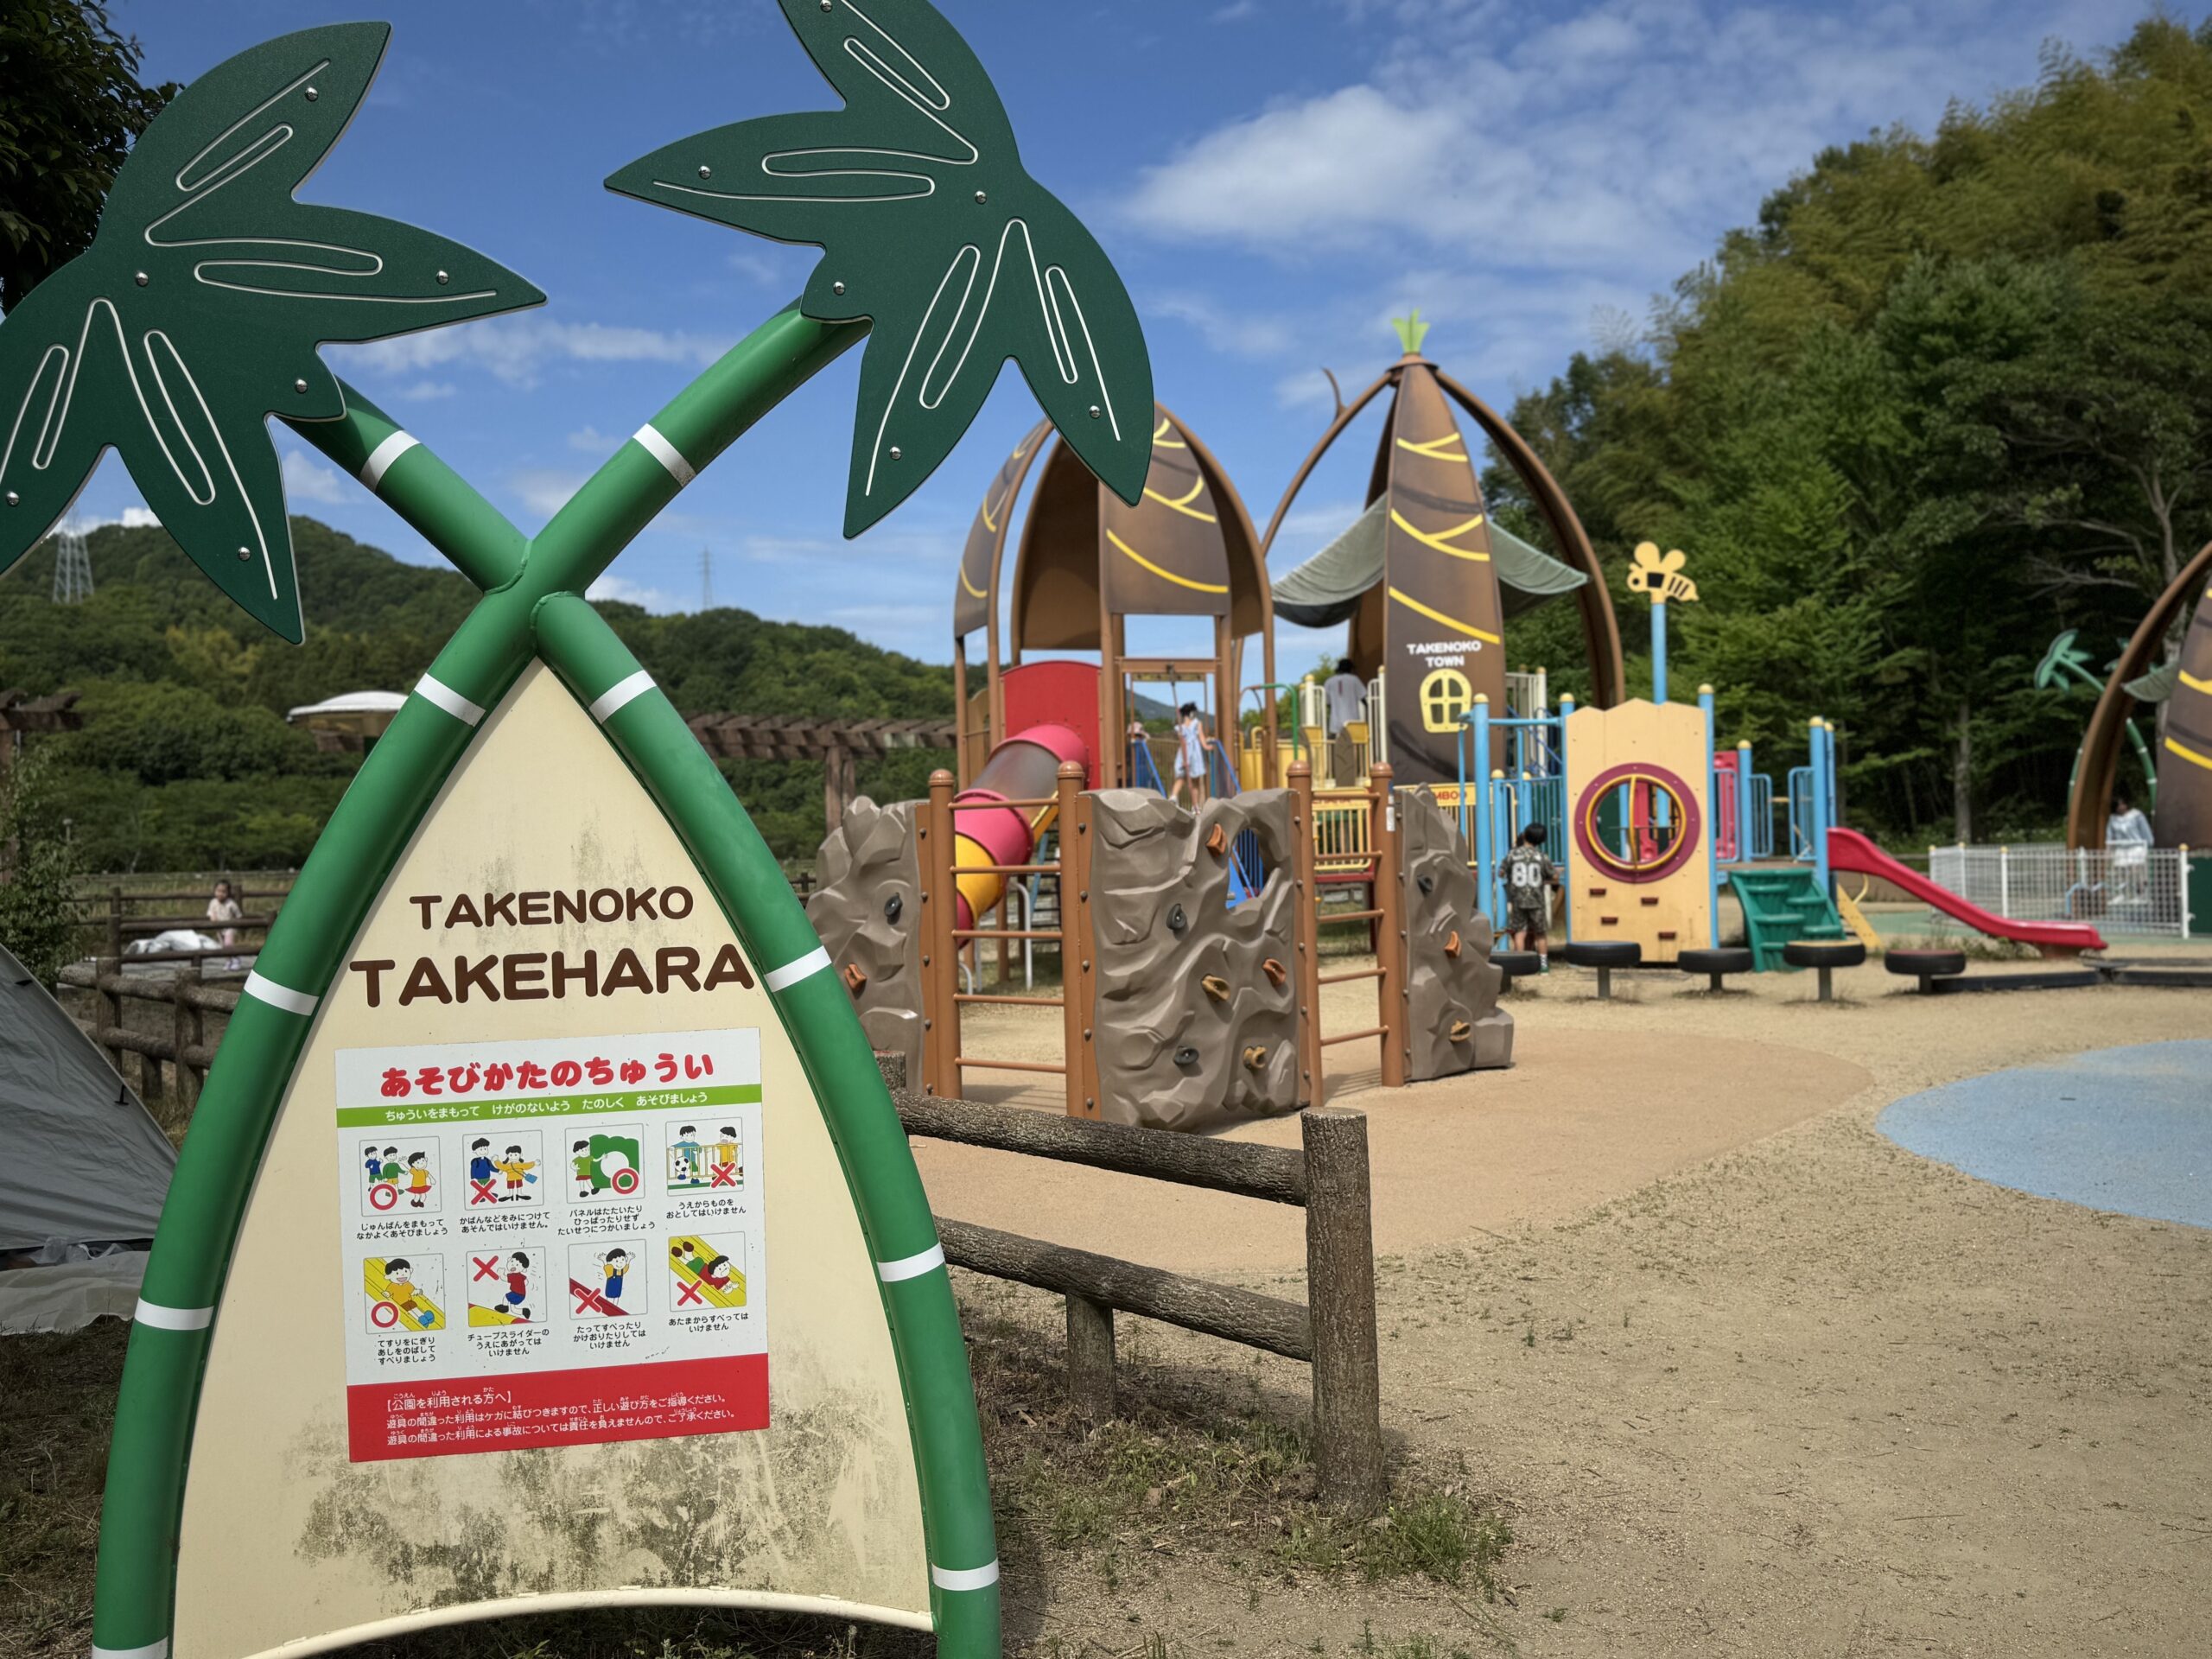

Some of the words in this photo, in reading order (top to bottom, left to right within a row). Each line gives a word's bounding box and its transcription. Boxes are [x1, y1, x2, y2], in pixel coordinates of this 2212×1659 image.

[1407, 640, 1482, 655] TAKENOKO
[1425, 656, 1465, 668] TOWN
[1512, 861, 1542, 887] 80
[409, 886, 694, 930] TAKENOKO
[349, 944, 755, 1007] TAKEHARA
[380, 1052, 714, 1097] あそびかたのちゅうい
[385, 1105, 480, 1122] ちゅういをまもって
[493, 1100, 571, 1116] けがのないよう
[582, 1096, 625, 1110] たのしく
[636, 1091, 709, 1107] あそびましょう
[678, 1198, 734, 1210] うえからものを
[689, 1324, 729, 1333] いけません
[488, 1347, 530, 1357] いけません
[589, 1339, 631, 1350] いけません
